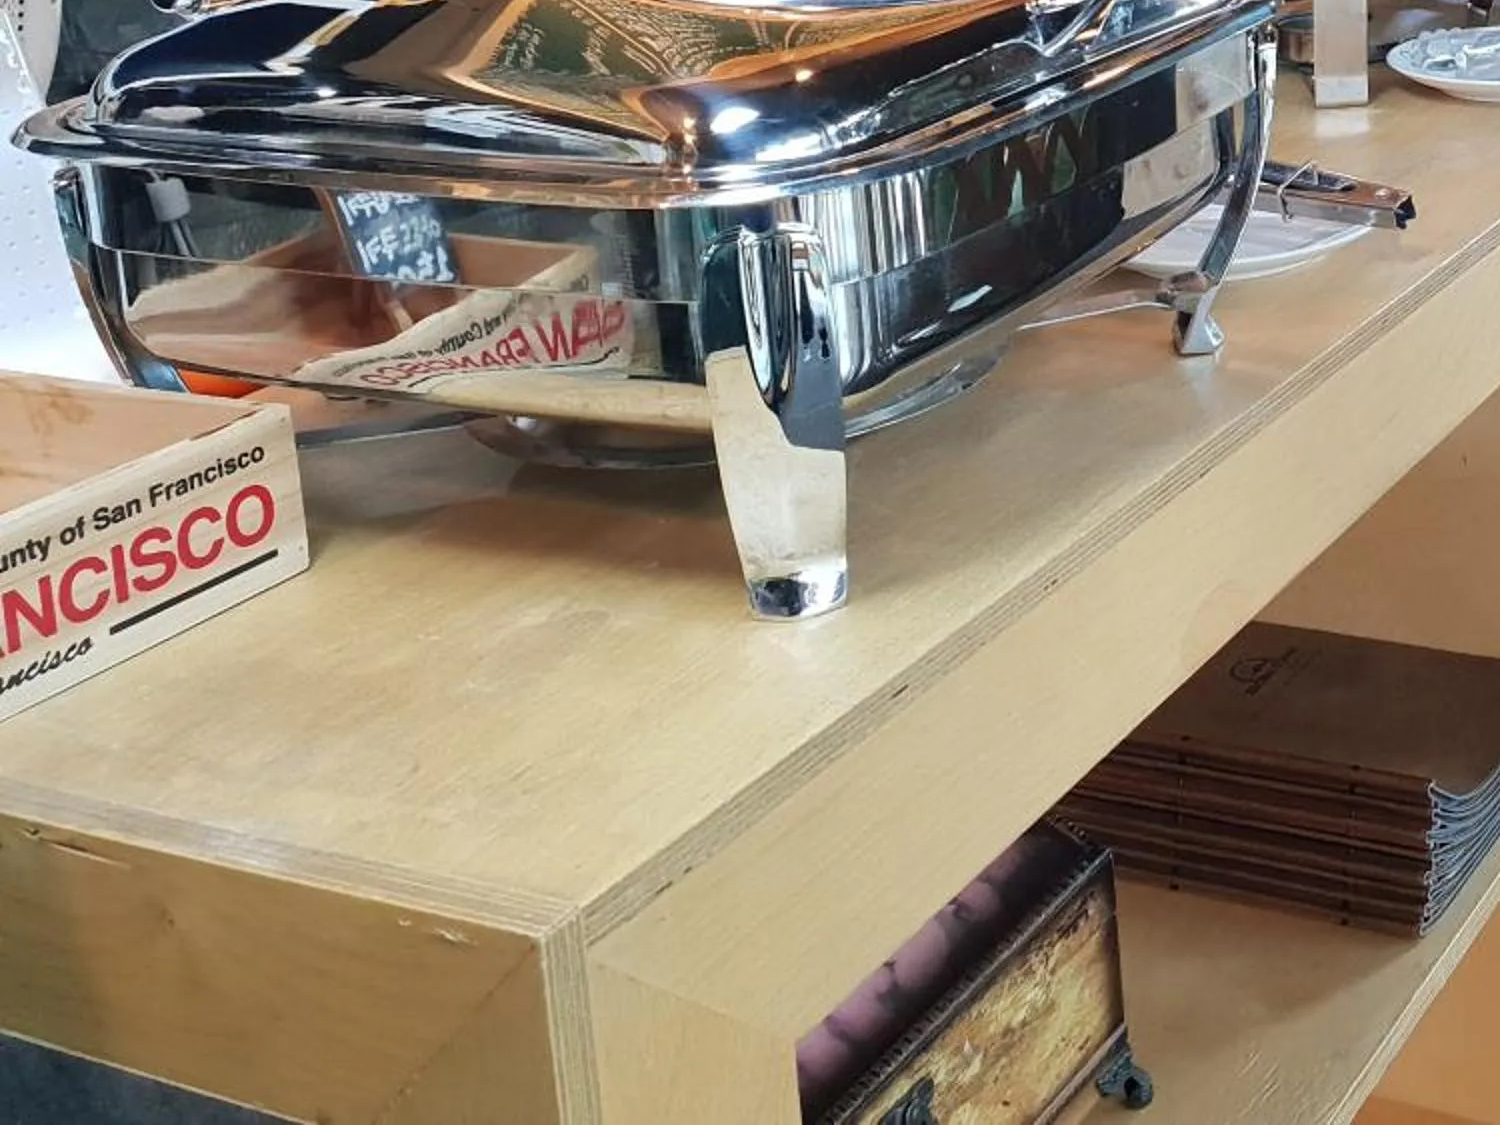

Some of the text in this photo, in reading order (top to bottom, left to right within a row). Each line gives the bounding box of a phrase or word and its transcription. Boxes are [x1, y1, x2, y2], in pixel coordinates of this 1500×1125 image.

[59, 515, 86, 546] of
[92, 497, 143, 532] San
[148, 445, 266, 508] Francisco
[0, 483, 276, 658] NCISCO
